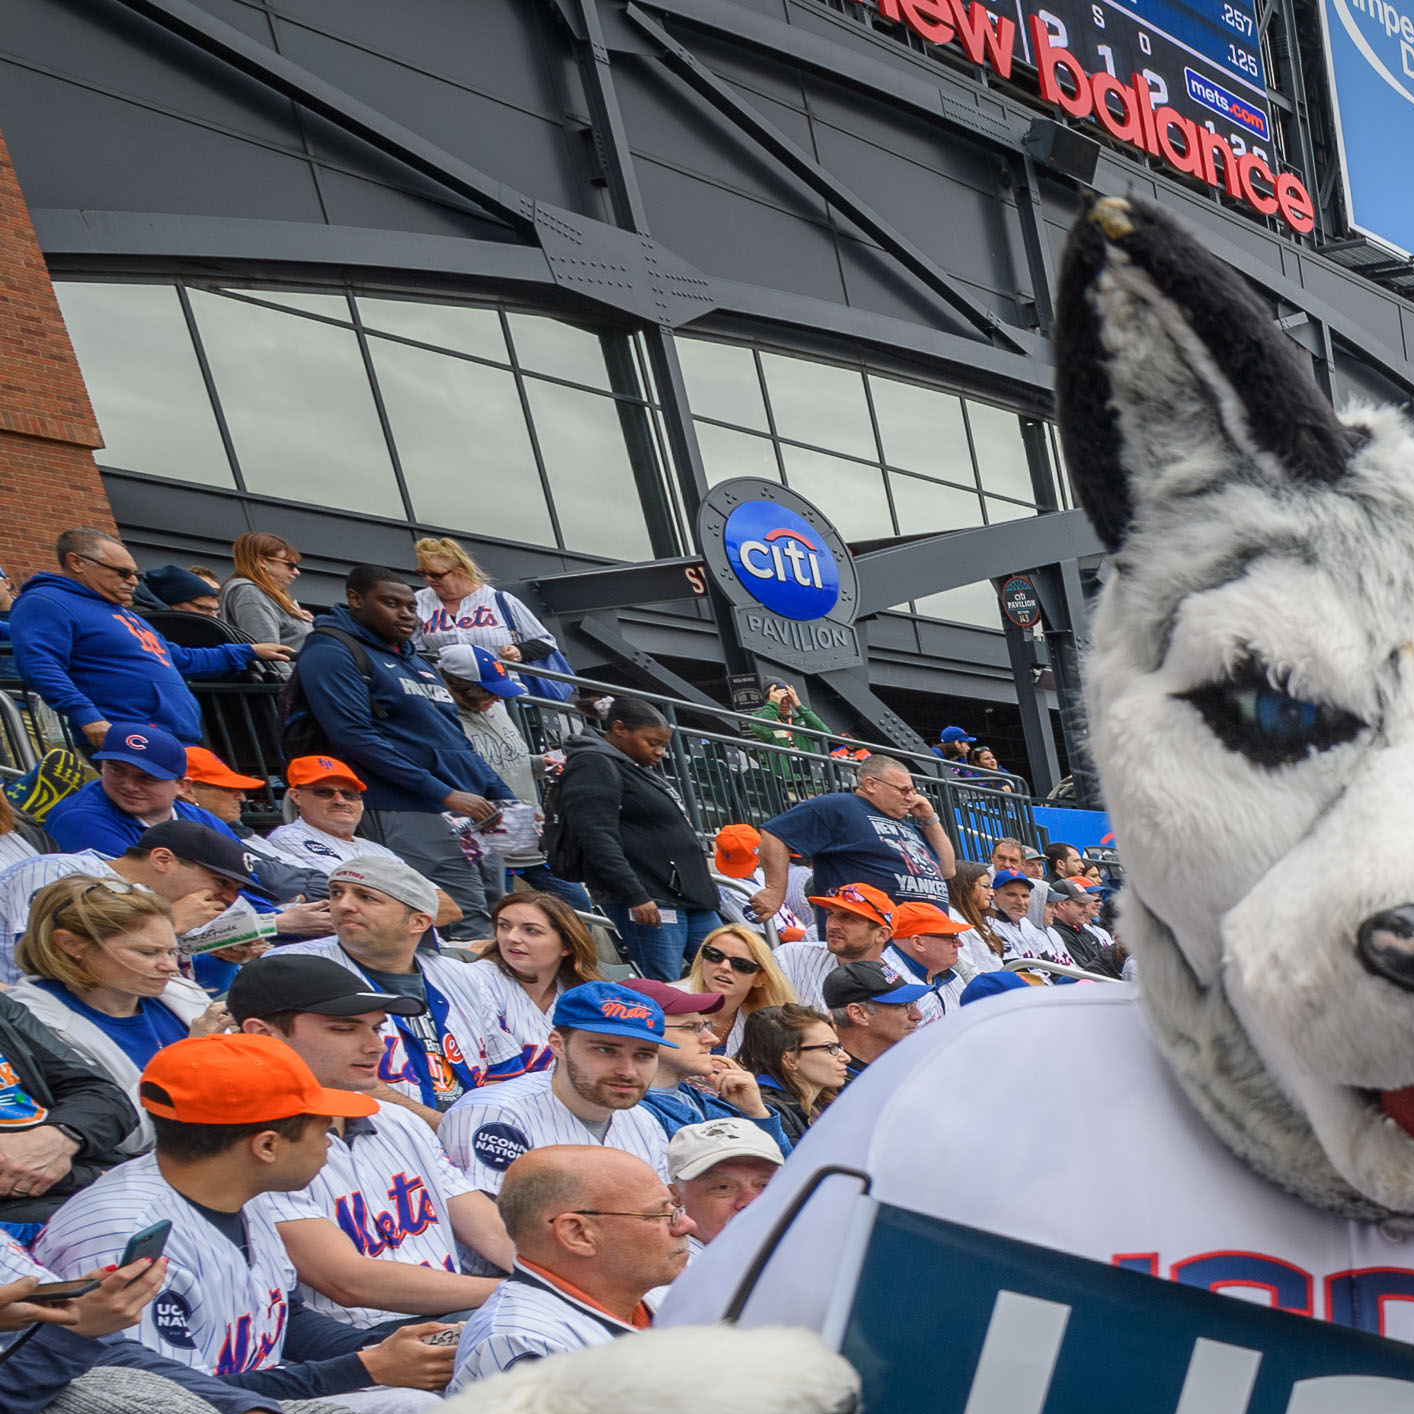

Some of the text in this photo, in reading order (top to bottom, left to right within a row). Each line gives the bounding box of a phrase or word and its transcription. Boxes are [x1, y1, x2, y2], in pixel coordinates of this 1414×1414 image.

[1222, 3, 1253, 37] .257
[1227, 43, 1258, 78] .125
[1030, 14, 1314, 233] balance
[1190, 79, 1265, 132] mets.com
[739, 528, 823, 590] citi
[421, 605, 500, 635] Mets
[747, 614, 849, 652] PAVILION
[478, 1132, 528, 1153] UCONN
[335, 1171, 440, 1258] Mets
